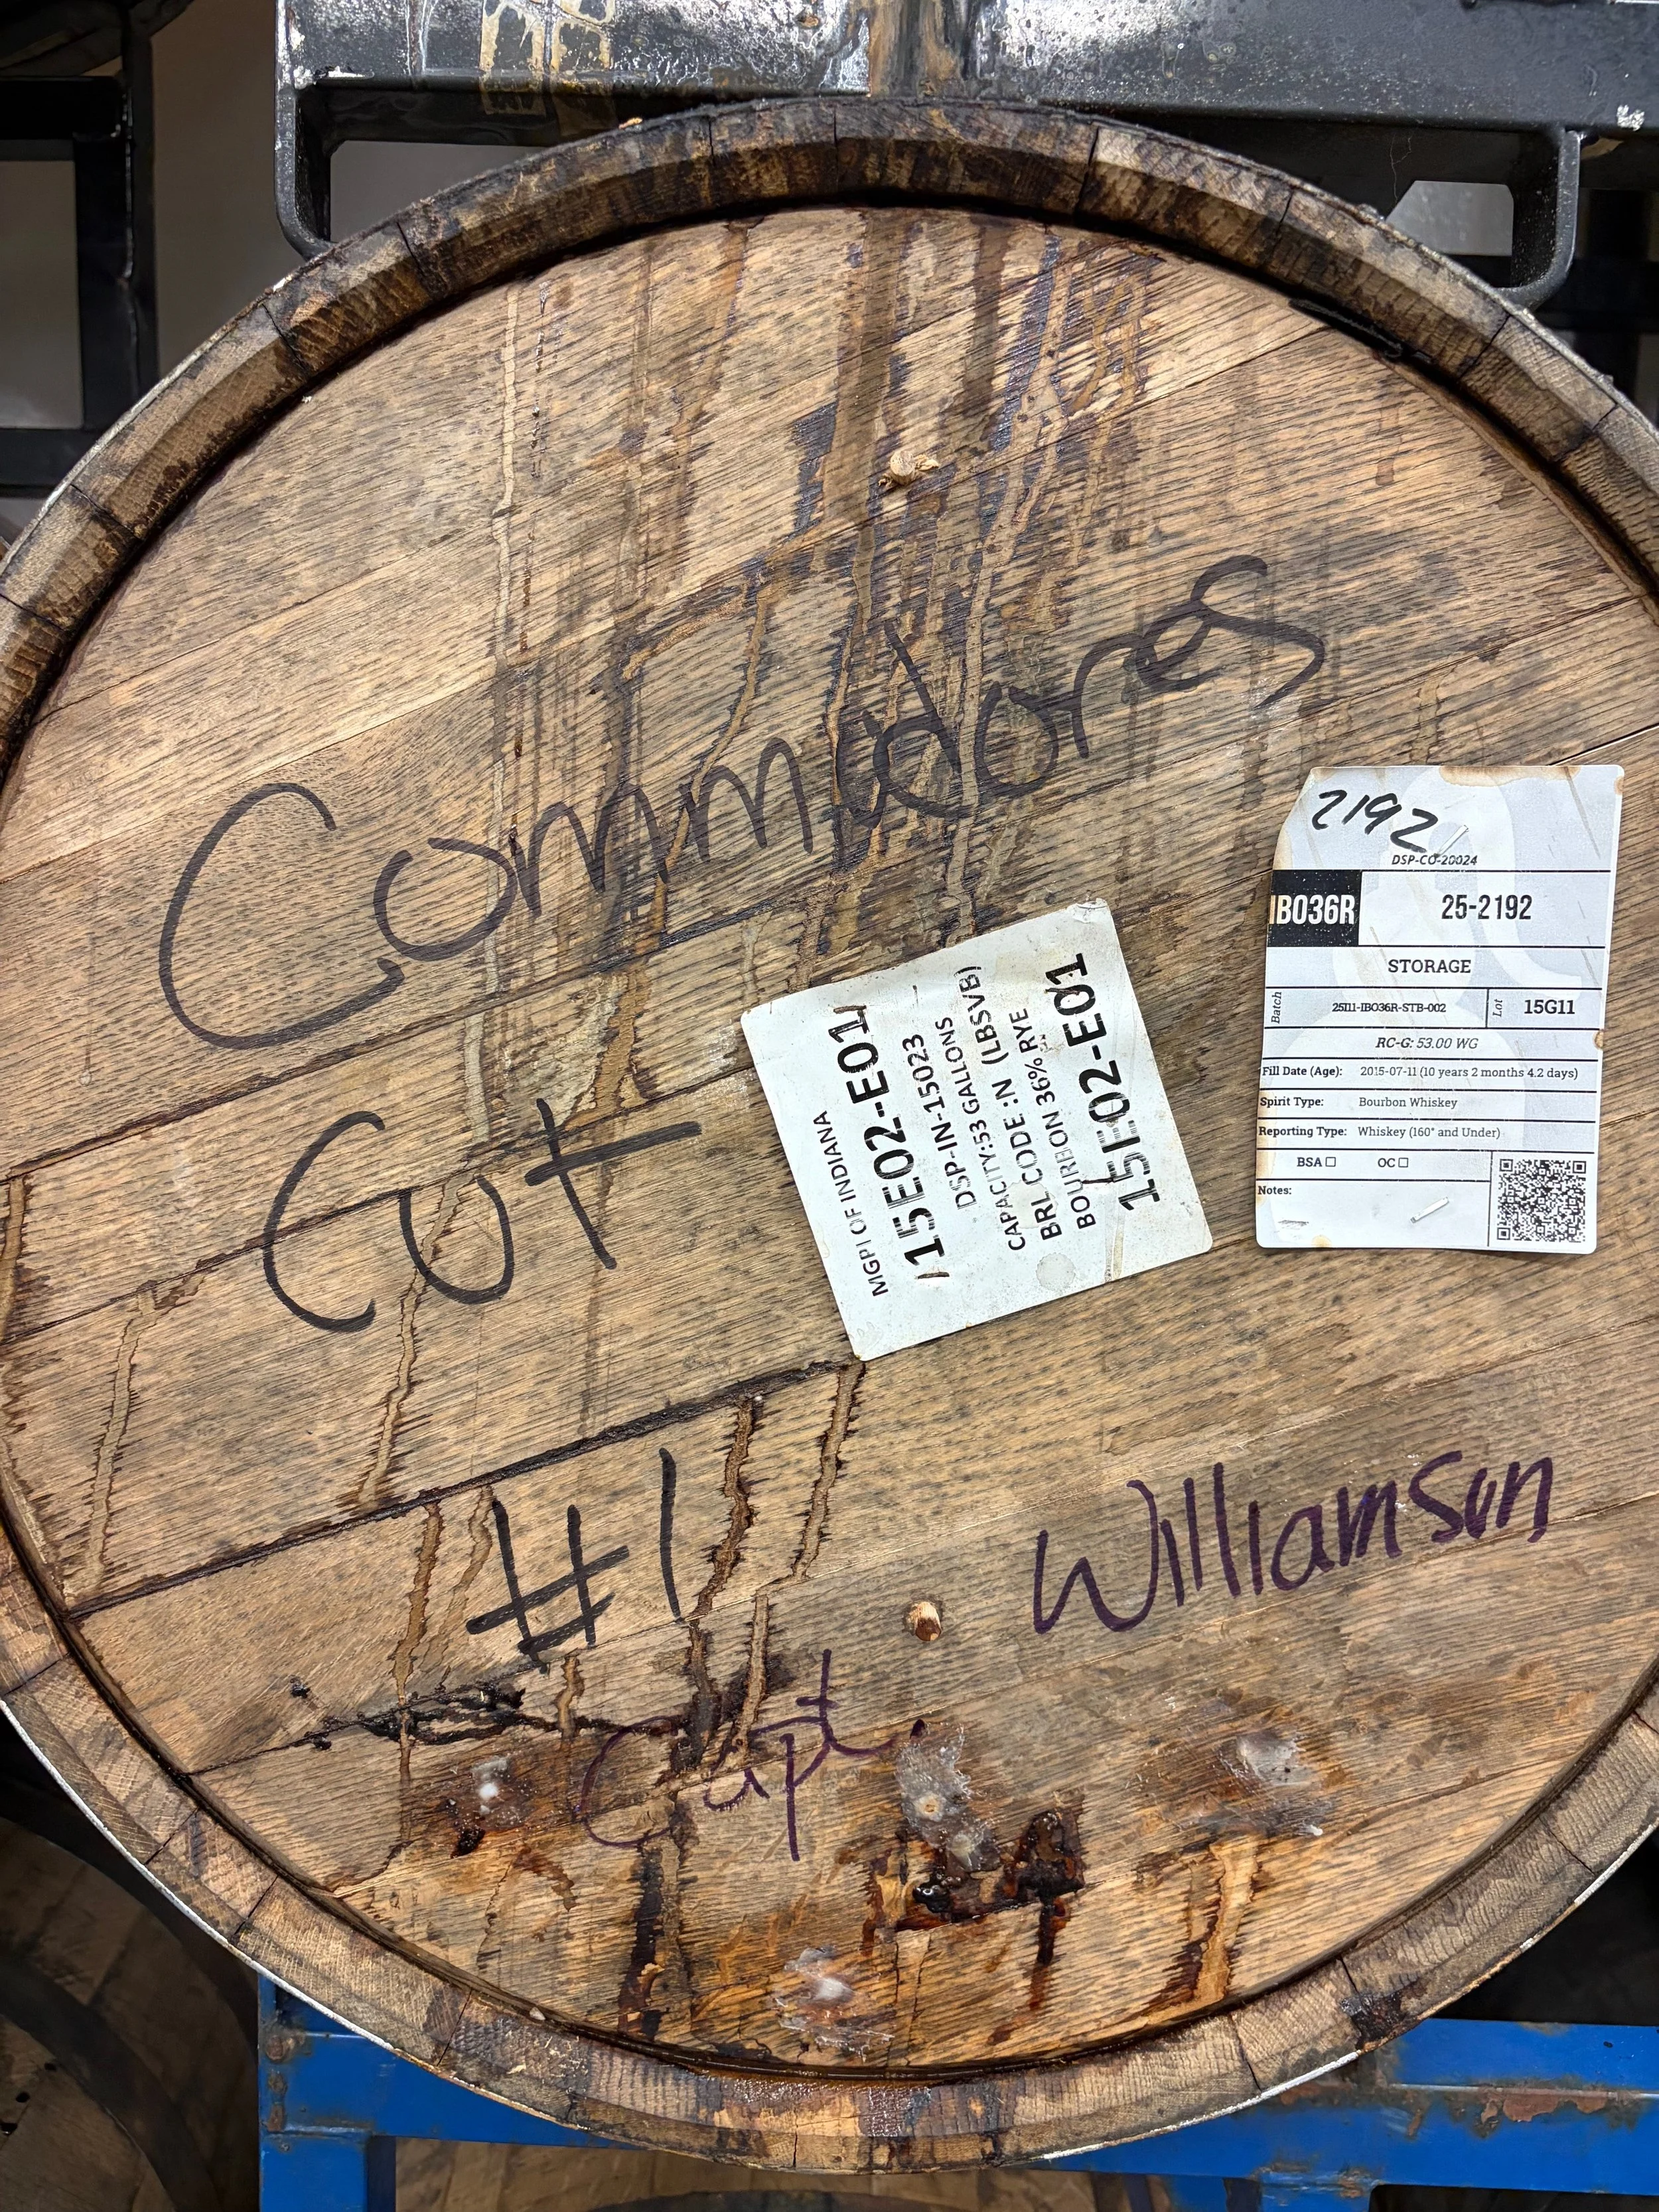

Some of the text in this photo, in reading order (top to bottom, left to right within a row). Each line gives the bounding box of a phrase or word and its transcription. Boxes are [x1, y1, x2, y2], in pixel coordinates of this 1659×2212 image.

[1312, 789, 1439, 853] 2192
[1441, 894, 1533, 920] 25-2192
[1388, 960, 1471, 974] STORAGE
[954, 966, 1010, 1066] (LBSVB)
[1271, 992, 1282, 1024] Batch
[1492, 999, 1503, 1017] Lot
[1524, 999, 1575, 1015] 15G11
[1376, 1037, 1479, 1049] RC-G: 53.00 WG
[935, 1016, 979, 1115] GALLONS
[1045, 953, 1161, 1211] 15E02-E01
[1262, 1066, 1579, 1080] Fill Date (Age): 2015-07-11 (10 years 2 months 4.2 days)
[902, 1033, 976, 1211] DSP-IN-15023
[1009, 1008, 1096, 1229] BOURBON 36% RYE
[1260, 1096, 1458, 1109] Spirit Type: Bourbon Whiskey
[828, 1009, 946, 1266] 15E02-E01
[1003, 1112, 1043, 1185] CODE
[1258, 1126, 1500, 1139] Reporting Type: Whiskey (160° and Under)
[1297, 1157, 1323, 1167] BSA
[1378, 1157, 1396, 1167] OC
[813, 1110, 889, 1297] MGPI OF INDIANA
[1258, 1185, 1292, 1195] Notes:
[263, 1098, 701, 1332] Cut
[1031, 1187, 1062, 1240] BRL
[466, 1447, 682, 1675] #1
